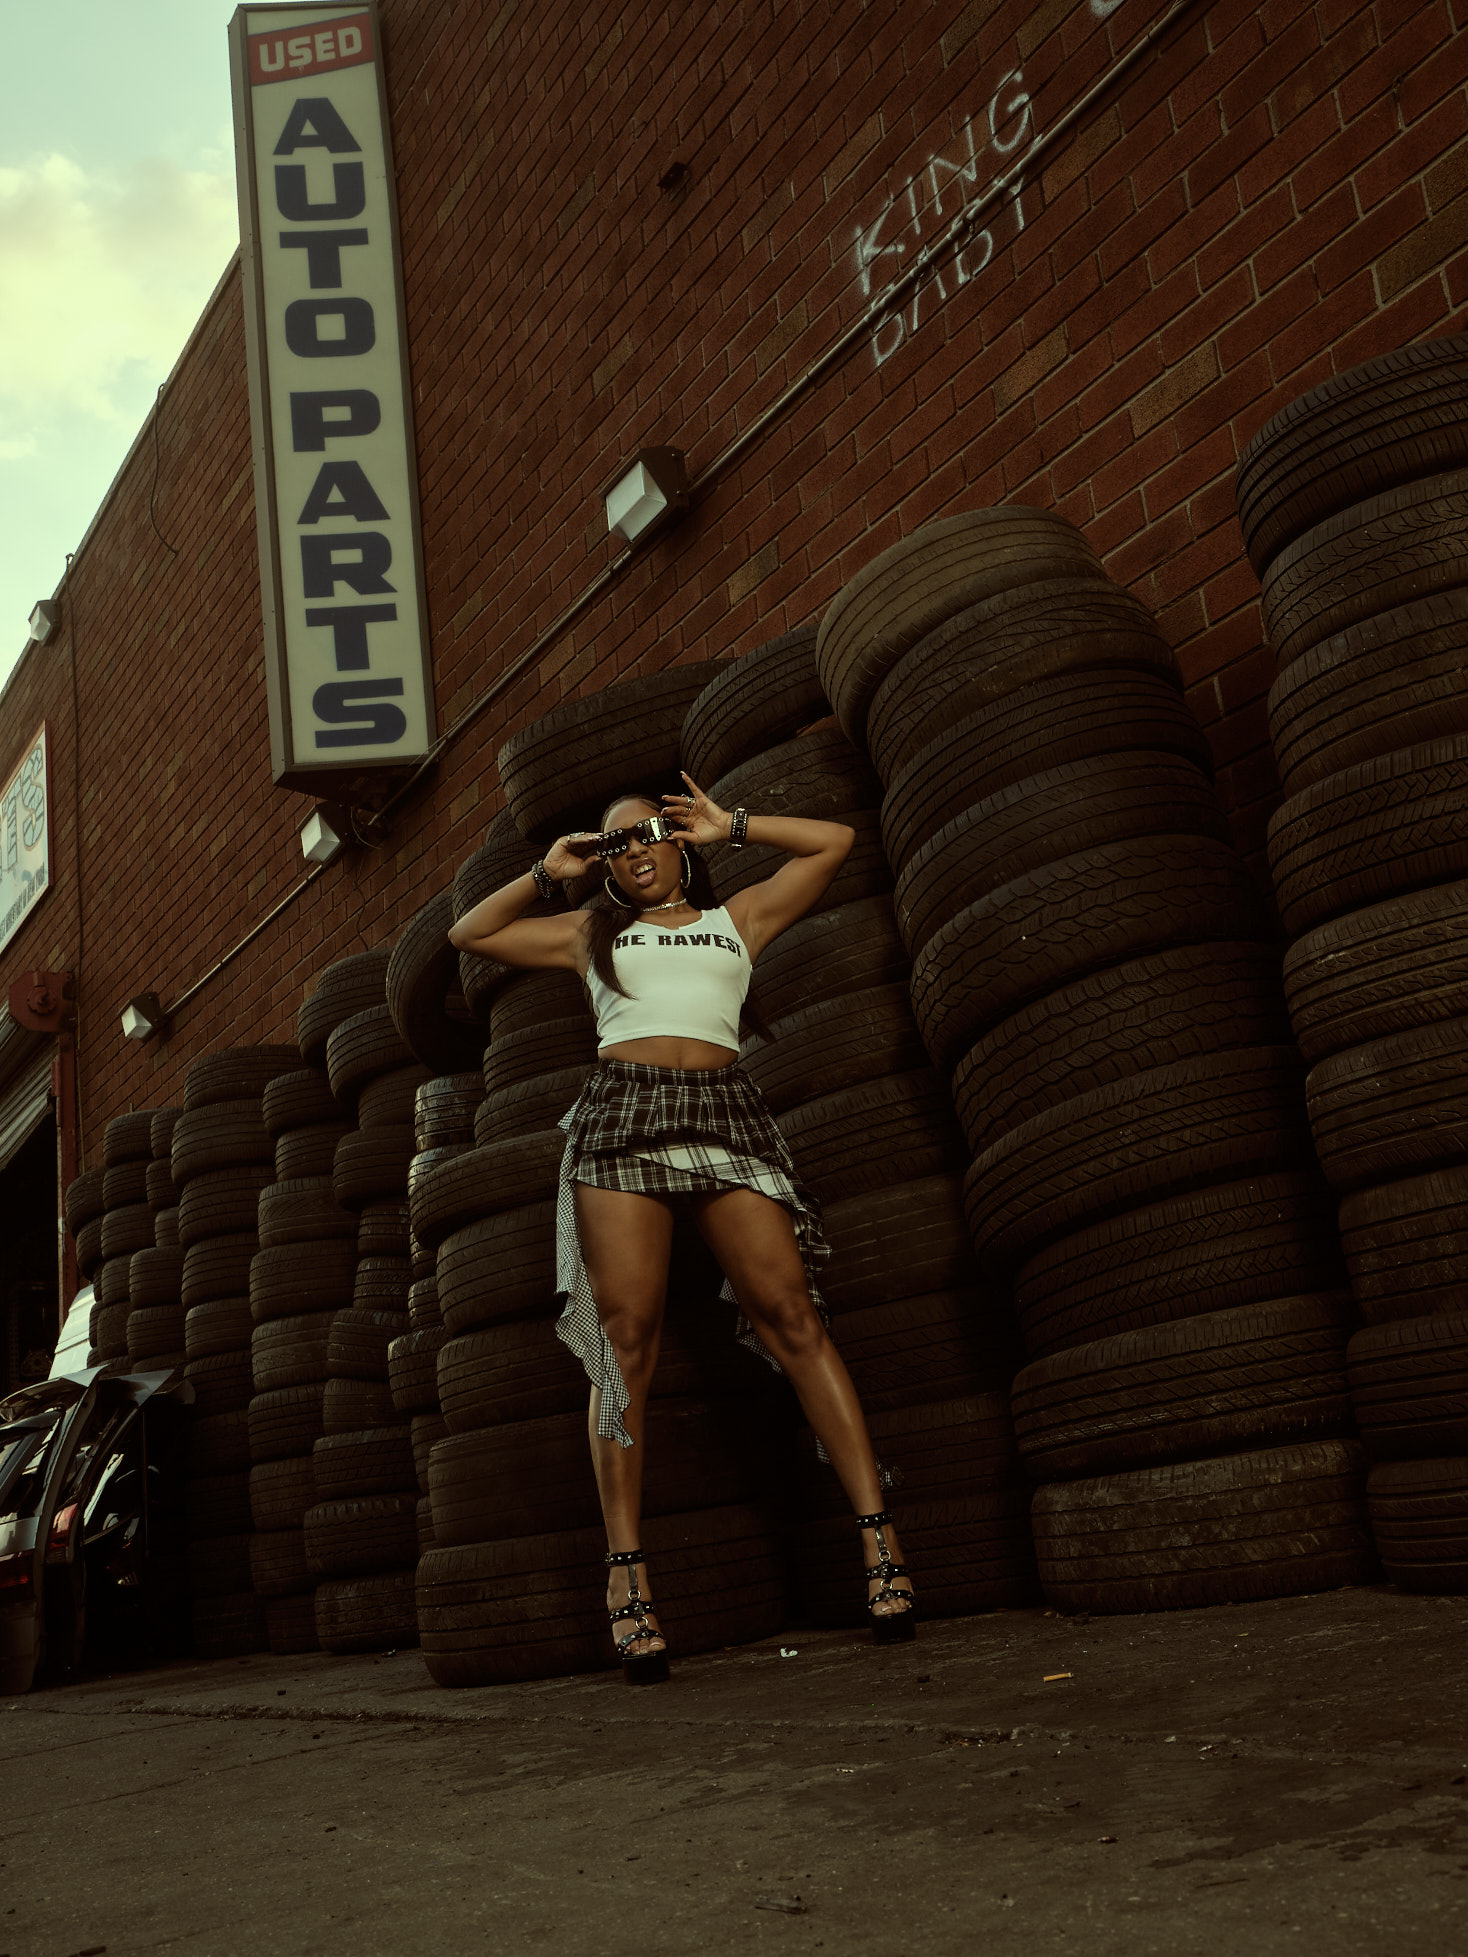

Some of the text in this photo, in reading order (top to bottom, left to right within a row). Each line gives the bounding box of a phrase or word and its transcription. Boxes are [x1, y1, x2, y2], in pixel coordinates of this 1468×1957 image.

[259, 26, 362, 72] USED
[853, 68, 1030, 296] KING
[272, 97, 407, 749] AUTO PARTS
[614, 933, 742, 958] HE RAWEST
